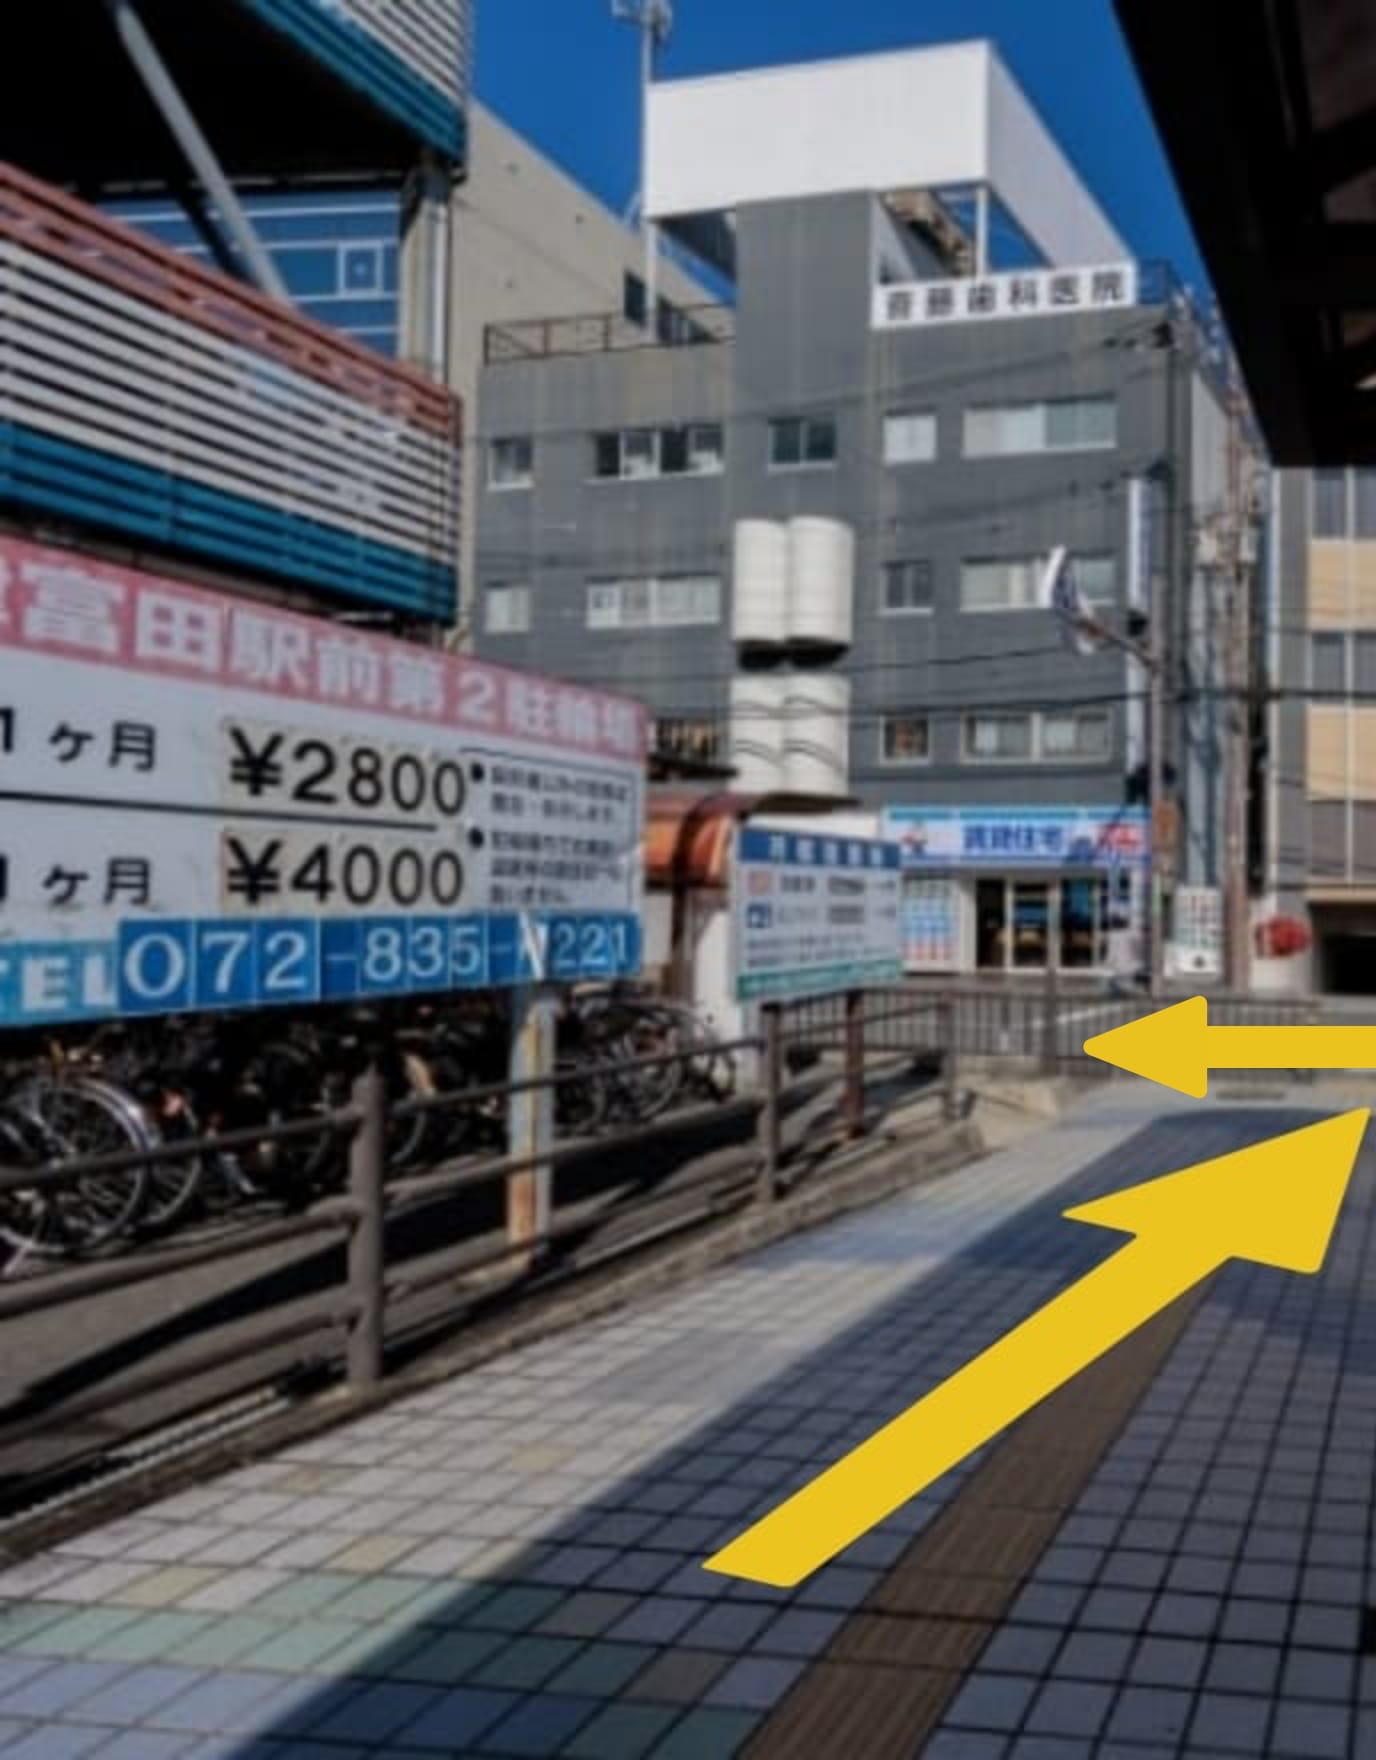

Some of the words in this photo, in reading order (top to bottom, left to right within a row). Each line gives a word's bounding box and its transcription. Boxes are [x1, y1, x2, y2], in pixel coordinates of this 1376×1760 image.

[229, 726, 466, 816] ¥2800
[226, 837, 464, 907] ¥4000
[123, 921, 627, 998] 072-835-221
